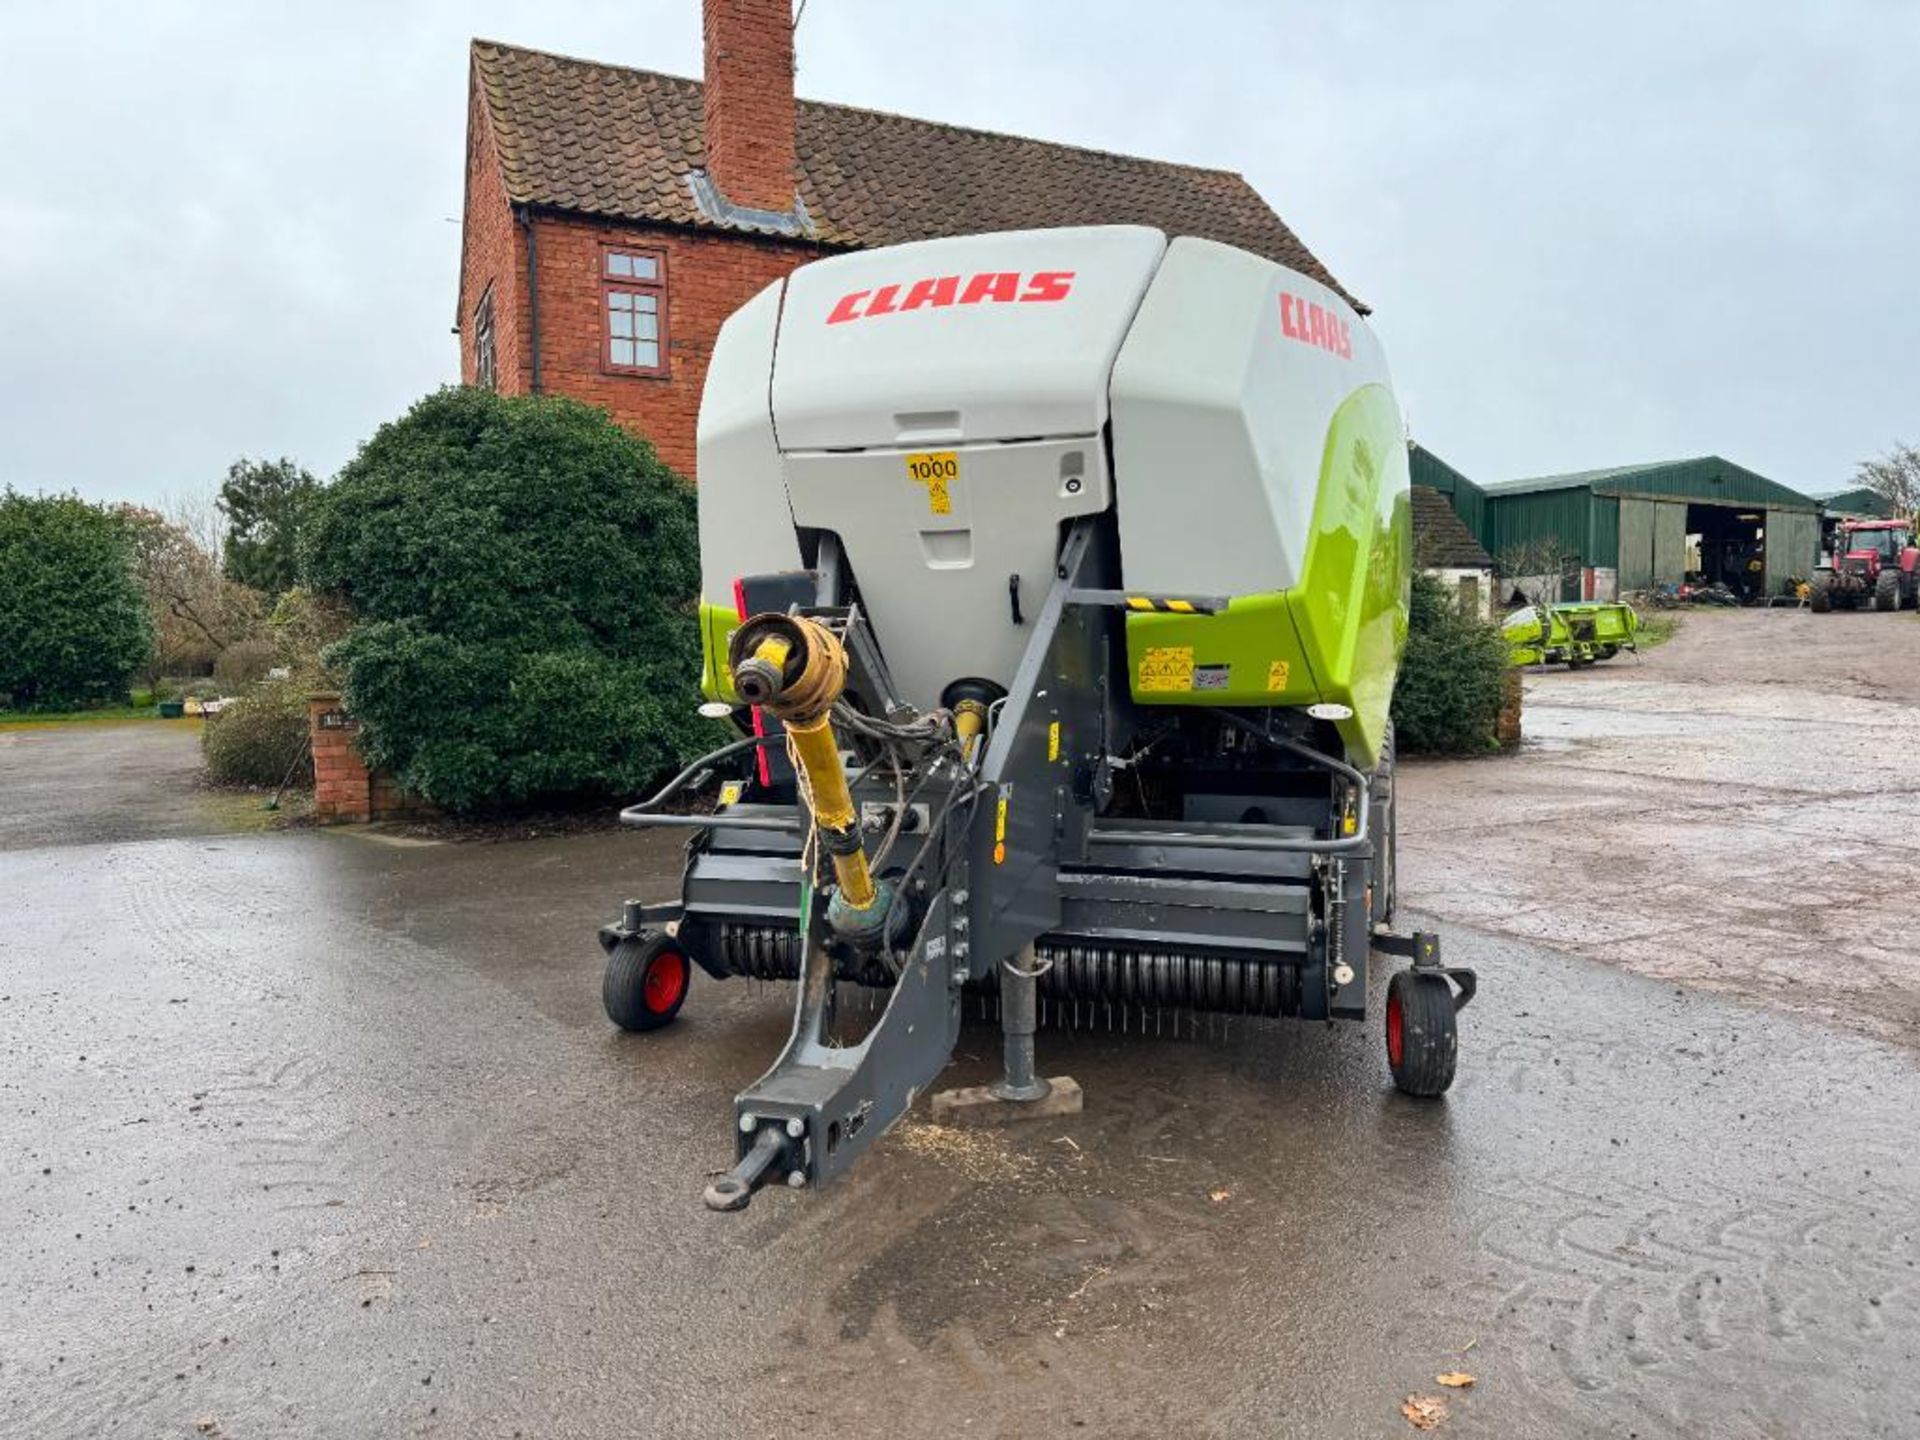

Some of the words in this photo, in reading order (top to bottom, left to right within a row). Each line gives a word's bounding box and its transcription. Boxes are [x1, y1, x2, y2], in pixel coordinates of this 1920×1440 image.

[827, 272, 1075, 325] CLAAS
[1279, 292, 1353, 360] CLAAS
[910, 460, 956, 479] 1000
